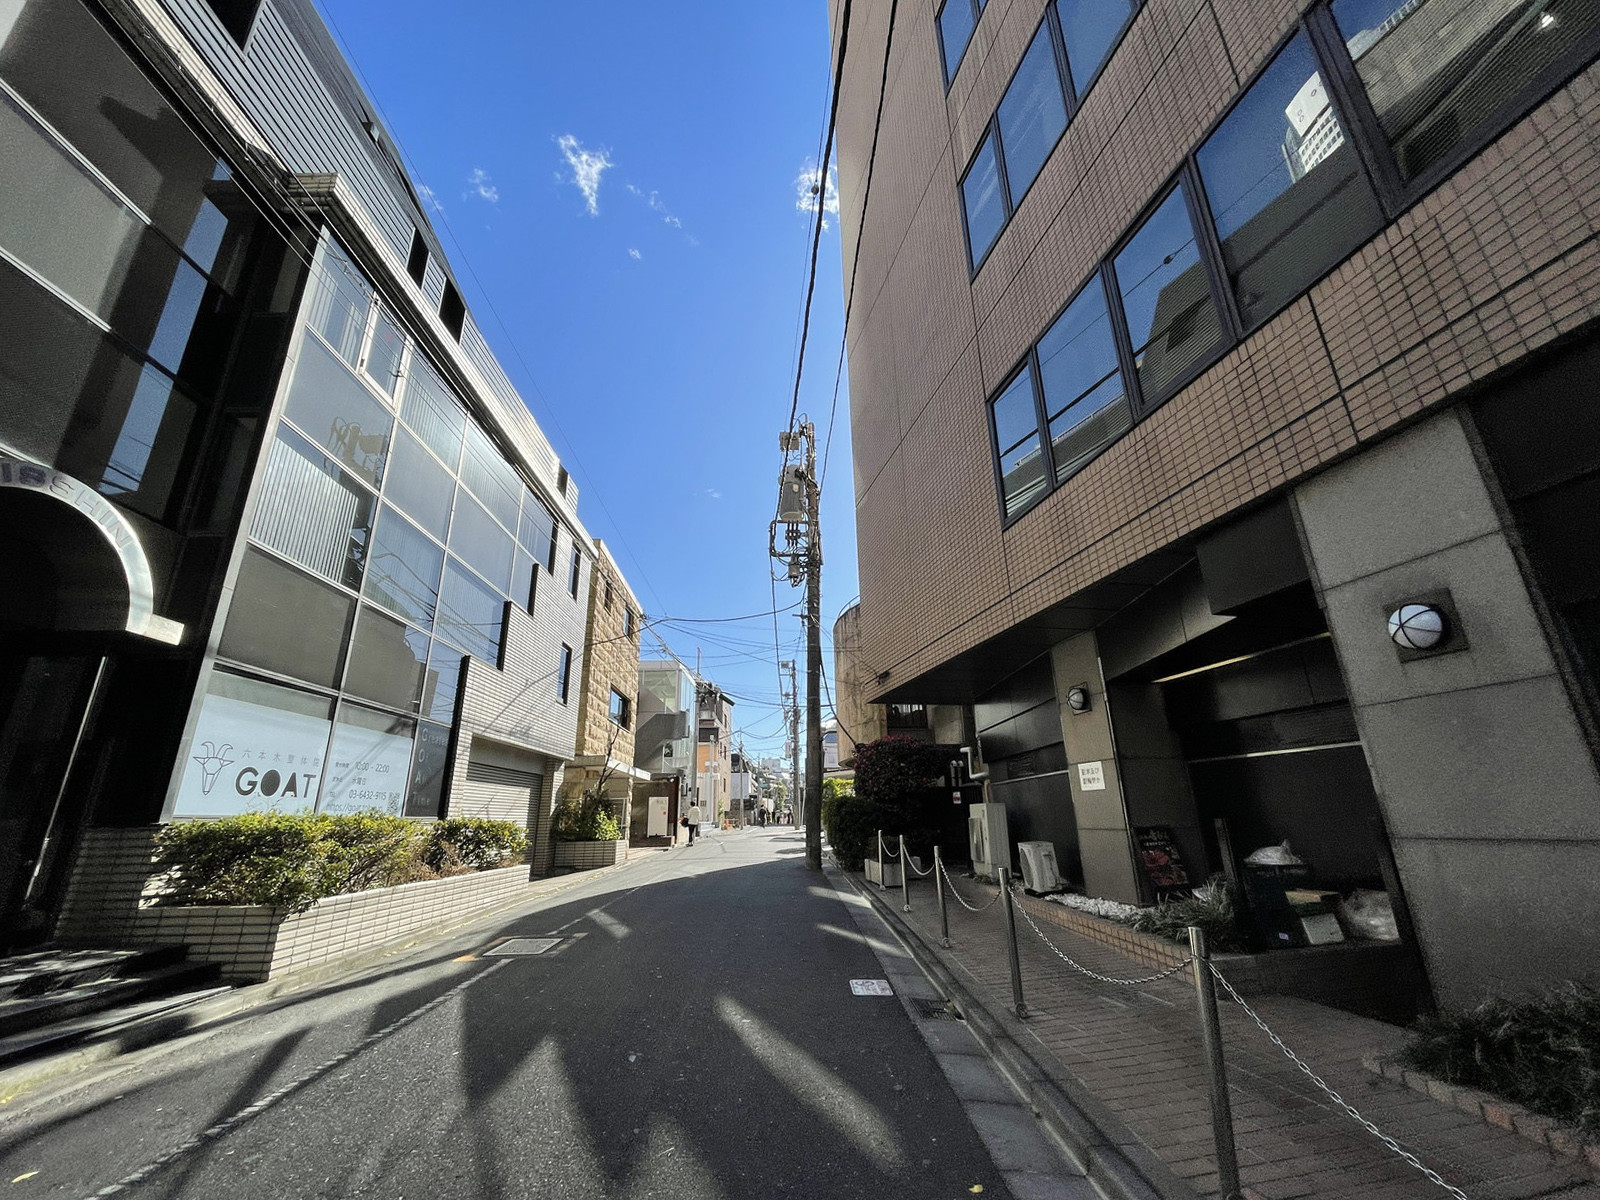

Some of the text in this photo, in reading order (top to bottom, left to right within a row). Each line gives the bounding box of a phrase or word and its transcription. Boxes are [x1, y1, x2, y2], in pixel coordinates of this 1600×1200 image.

[241, 748, 320, 767] 六本木整体院
[375, 763, 390, 773] 22:00
[235, 766, 317, 798] GOAT
